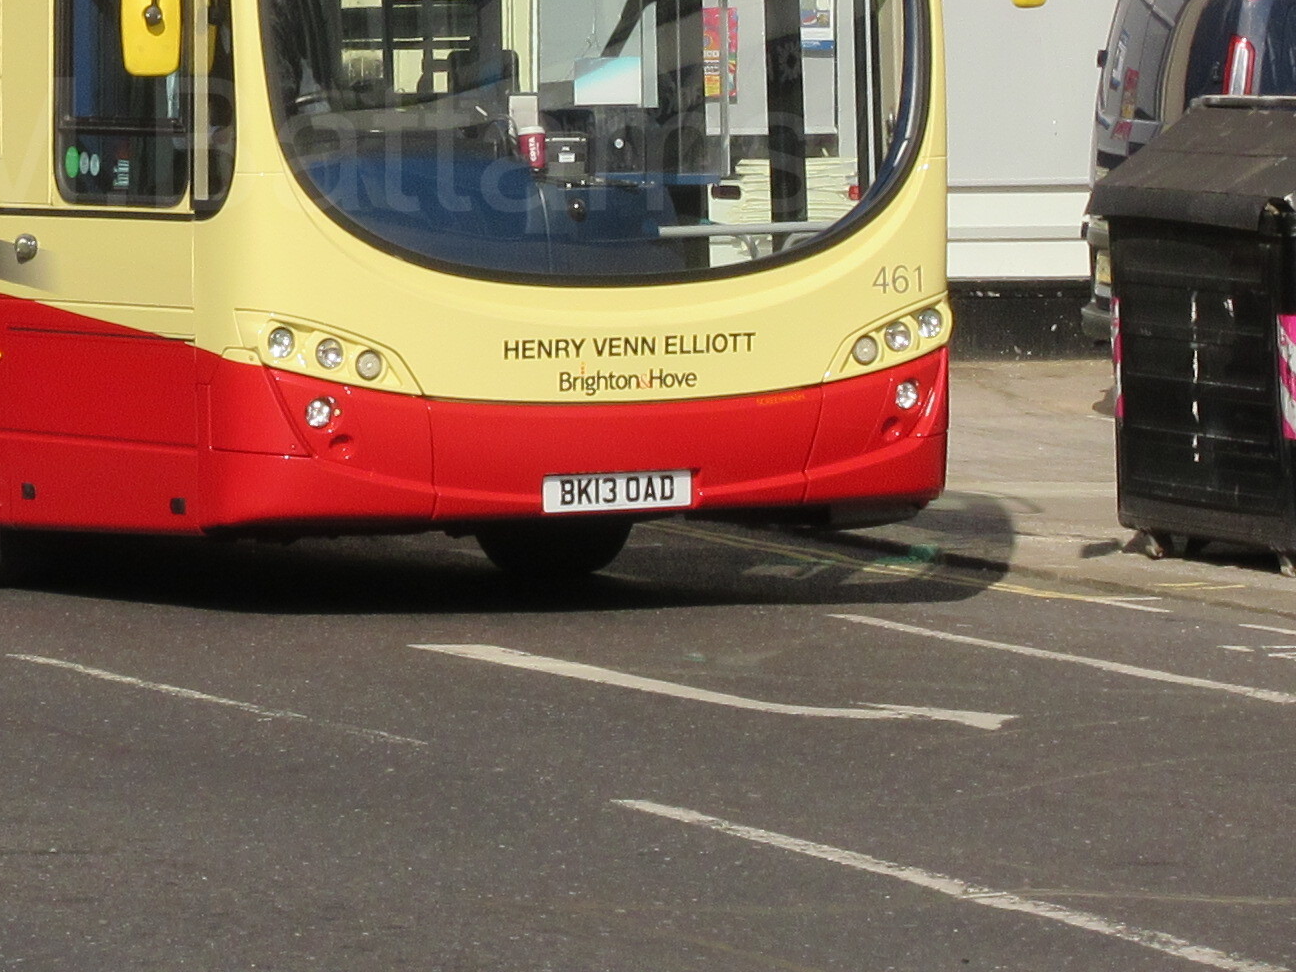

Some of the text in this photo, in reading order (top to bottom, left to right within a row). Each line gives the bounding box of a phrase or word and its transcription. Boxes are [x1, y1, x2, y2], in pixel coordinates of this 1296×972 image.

[528, 136, 538, 162] COSTA
[871, 264, 923, 294] 461
[503, 331, 757, 361] HENRY VENN ELLIOTT
[558, 364, 698, 396] Brighton&Hove
[559, 475, 675, 506] BK13 OAD
